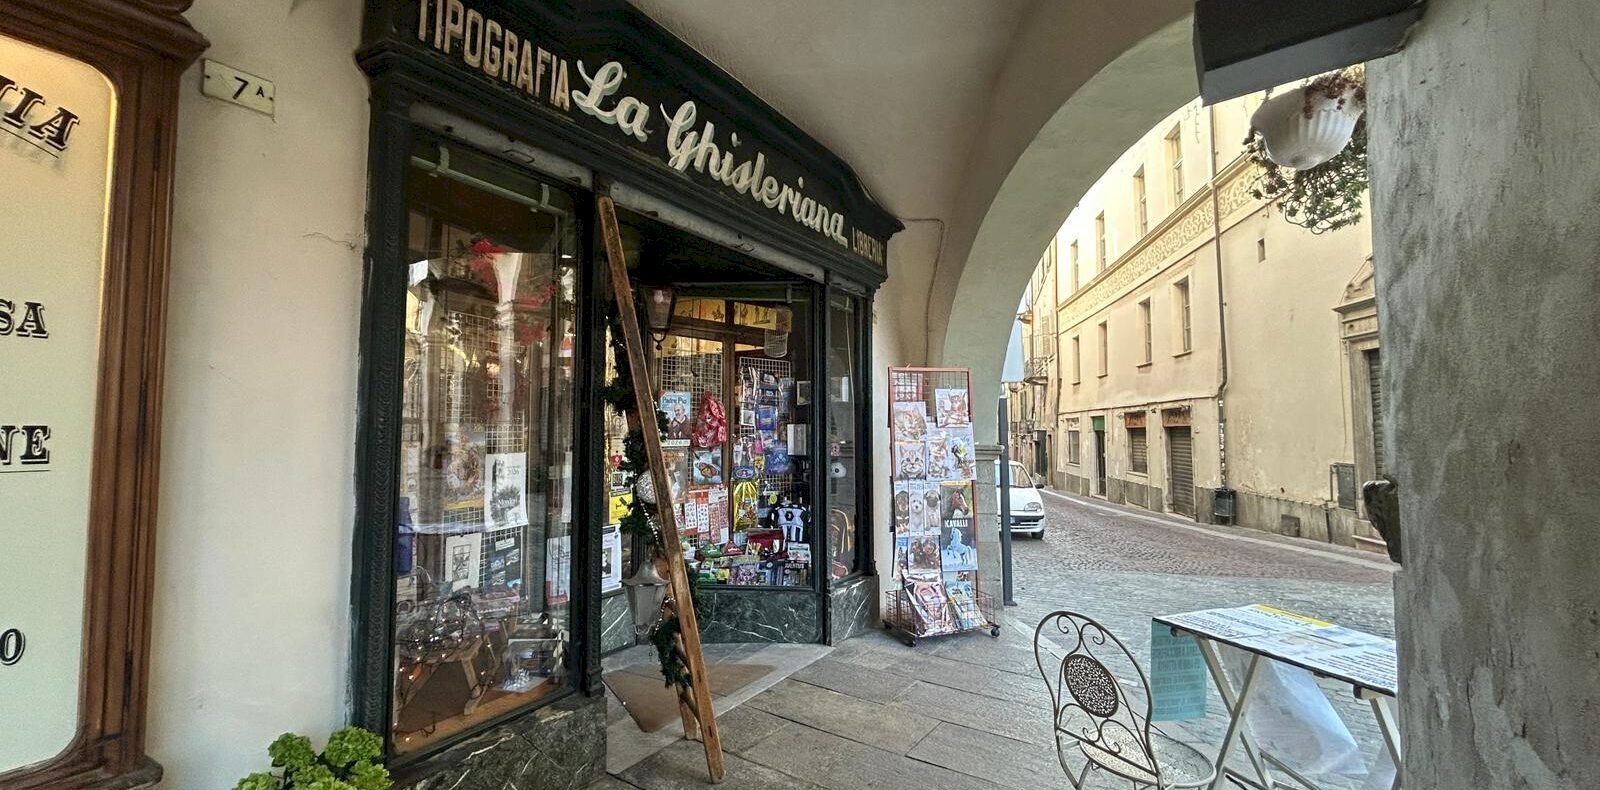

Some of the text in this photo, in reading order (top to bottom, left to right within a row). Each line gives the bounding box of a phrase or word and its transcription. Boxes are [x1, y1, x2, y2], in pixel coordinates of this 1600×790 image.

[232, 76, 265, 100] 7 A
[572, 60, 848, 249] La Ghisleriana
